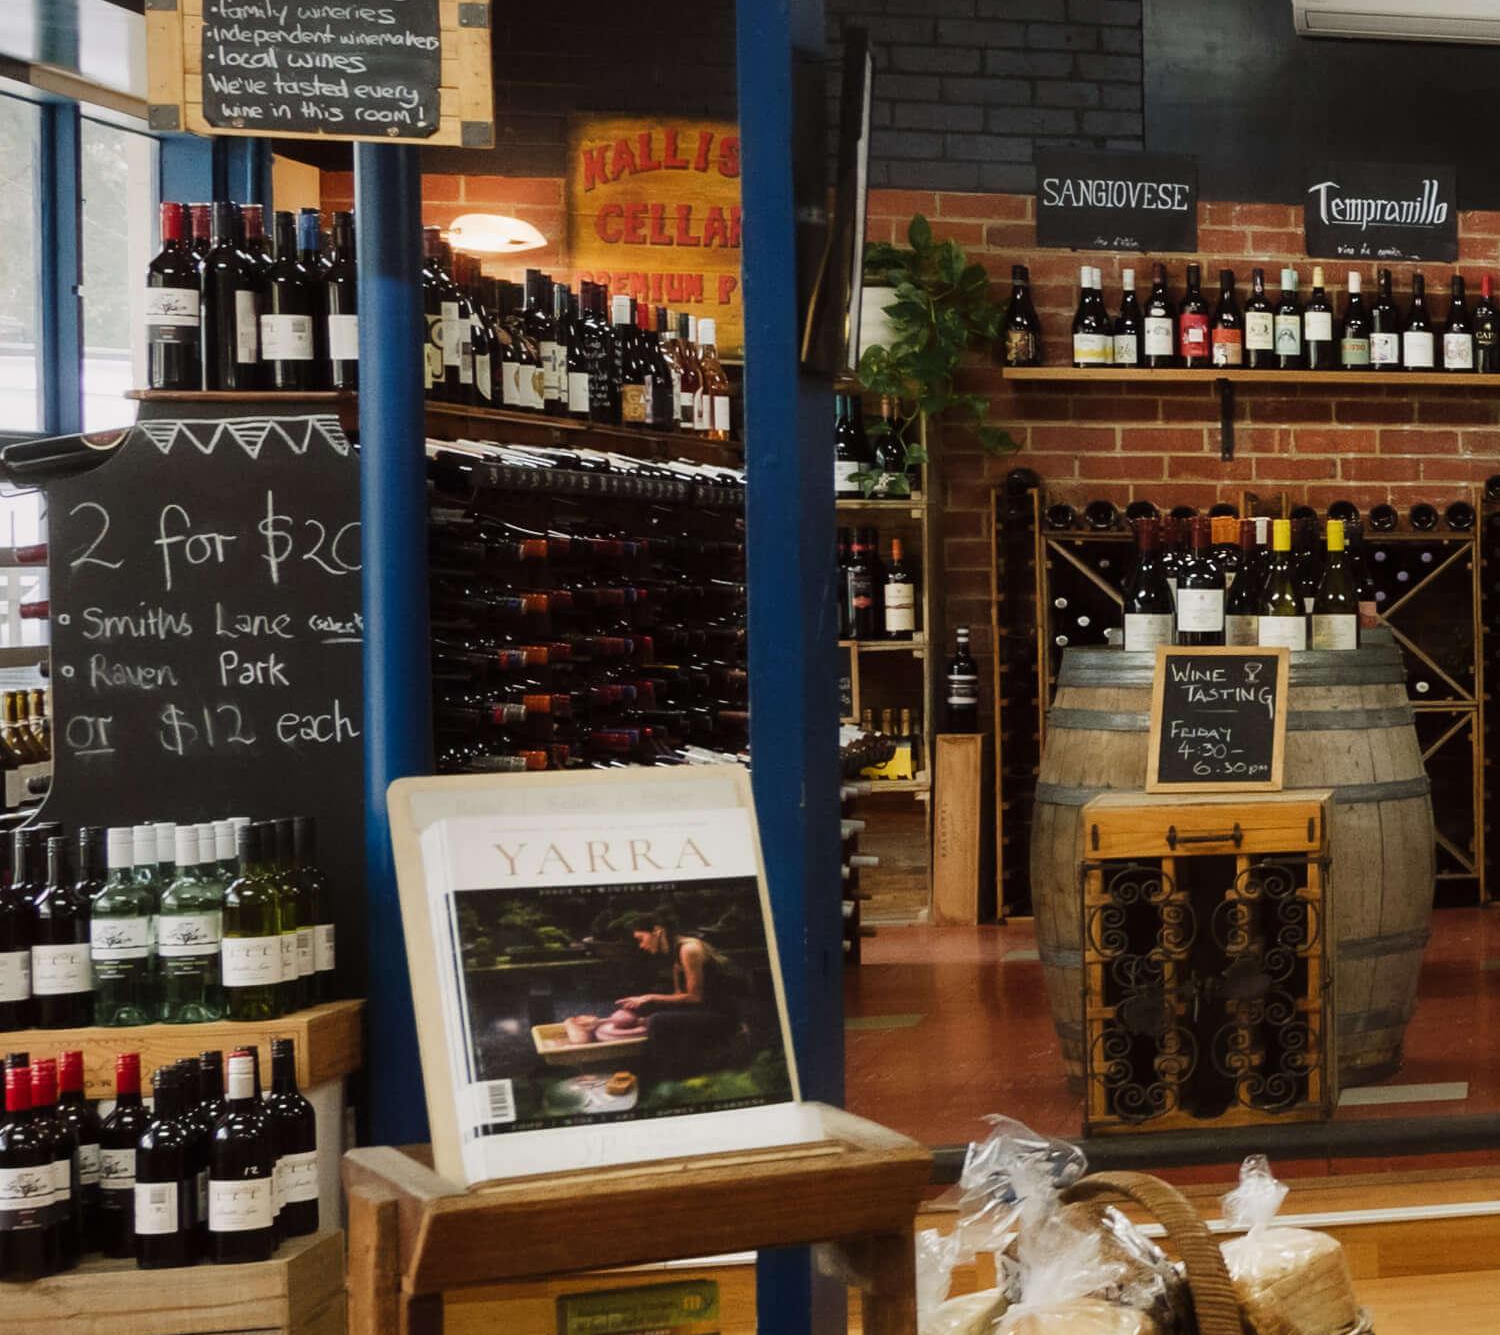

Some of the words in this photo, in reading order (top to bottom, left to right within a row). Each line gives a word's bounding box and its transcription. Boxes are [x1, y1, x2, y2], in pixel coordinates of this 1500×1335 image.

[298, 6, 396, 24] wineries
[340, 30, 440, 51] winemakers
[219, 45, 278, 69] local
[288, 52, 367, 74] wines
[208, 73, 268, 95] We've
[273, 72, 349, 98] tasted
[354, 83, 419, 109] every
[221, 102, 264, 119] wine
[271, 102, 291, 119] in
[301, 101, 344, 122] this
[1043, 178, 1190, 211] SANGIOVESE
[1308, 179, 1449, 231] Tempranillo
[69, 501, 126, 569] 2
[154, 504, 237, 592] for
[82, 601, 193, 641] Smiths
[215, 602, 296, 639] Lane
[89, 653, 179, 690] Raven
[219, 650, 290, 687] Park
[1171, 662, 1227, 682] WINE
[1180, 683, 1273, 720] TASTING
[65, 715, 114, 750] or
[159, 703, 257, 756] $12
[276, 698, 361, 743] each
[1170, 720, 1231, 742] FRIDAY
[495, 837, 712, 877] YARRA
